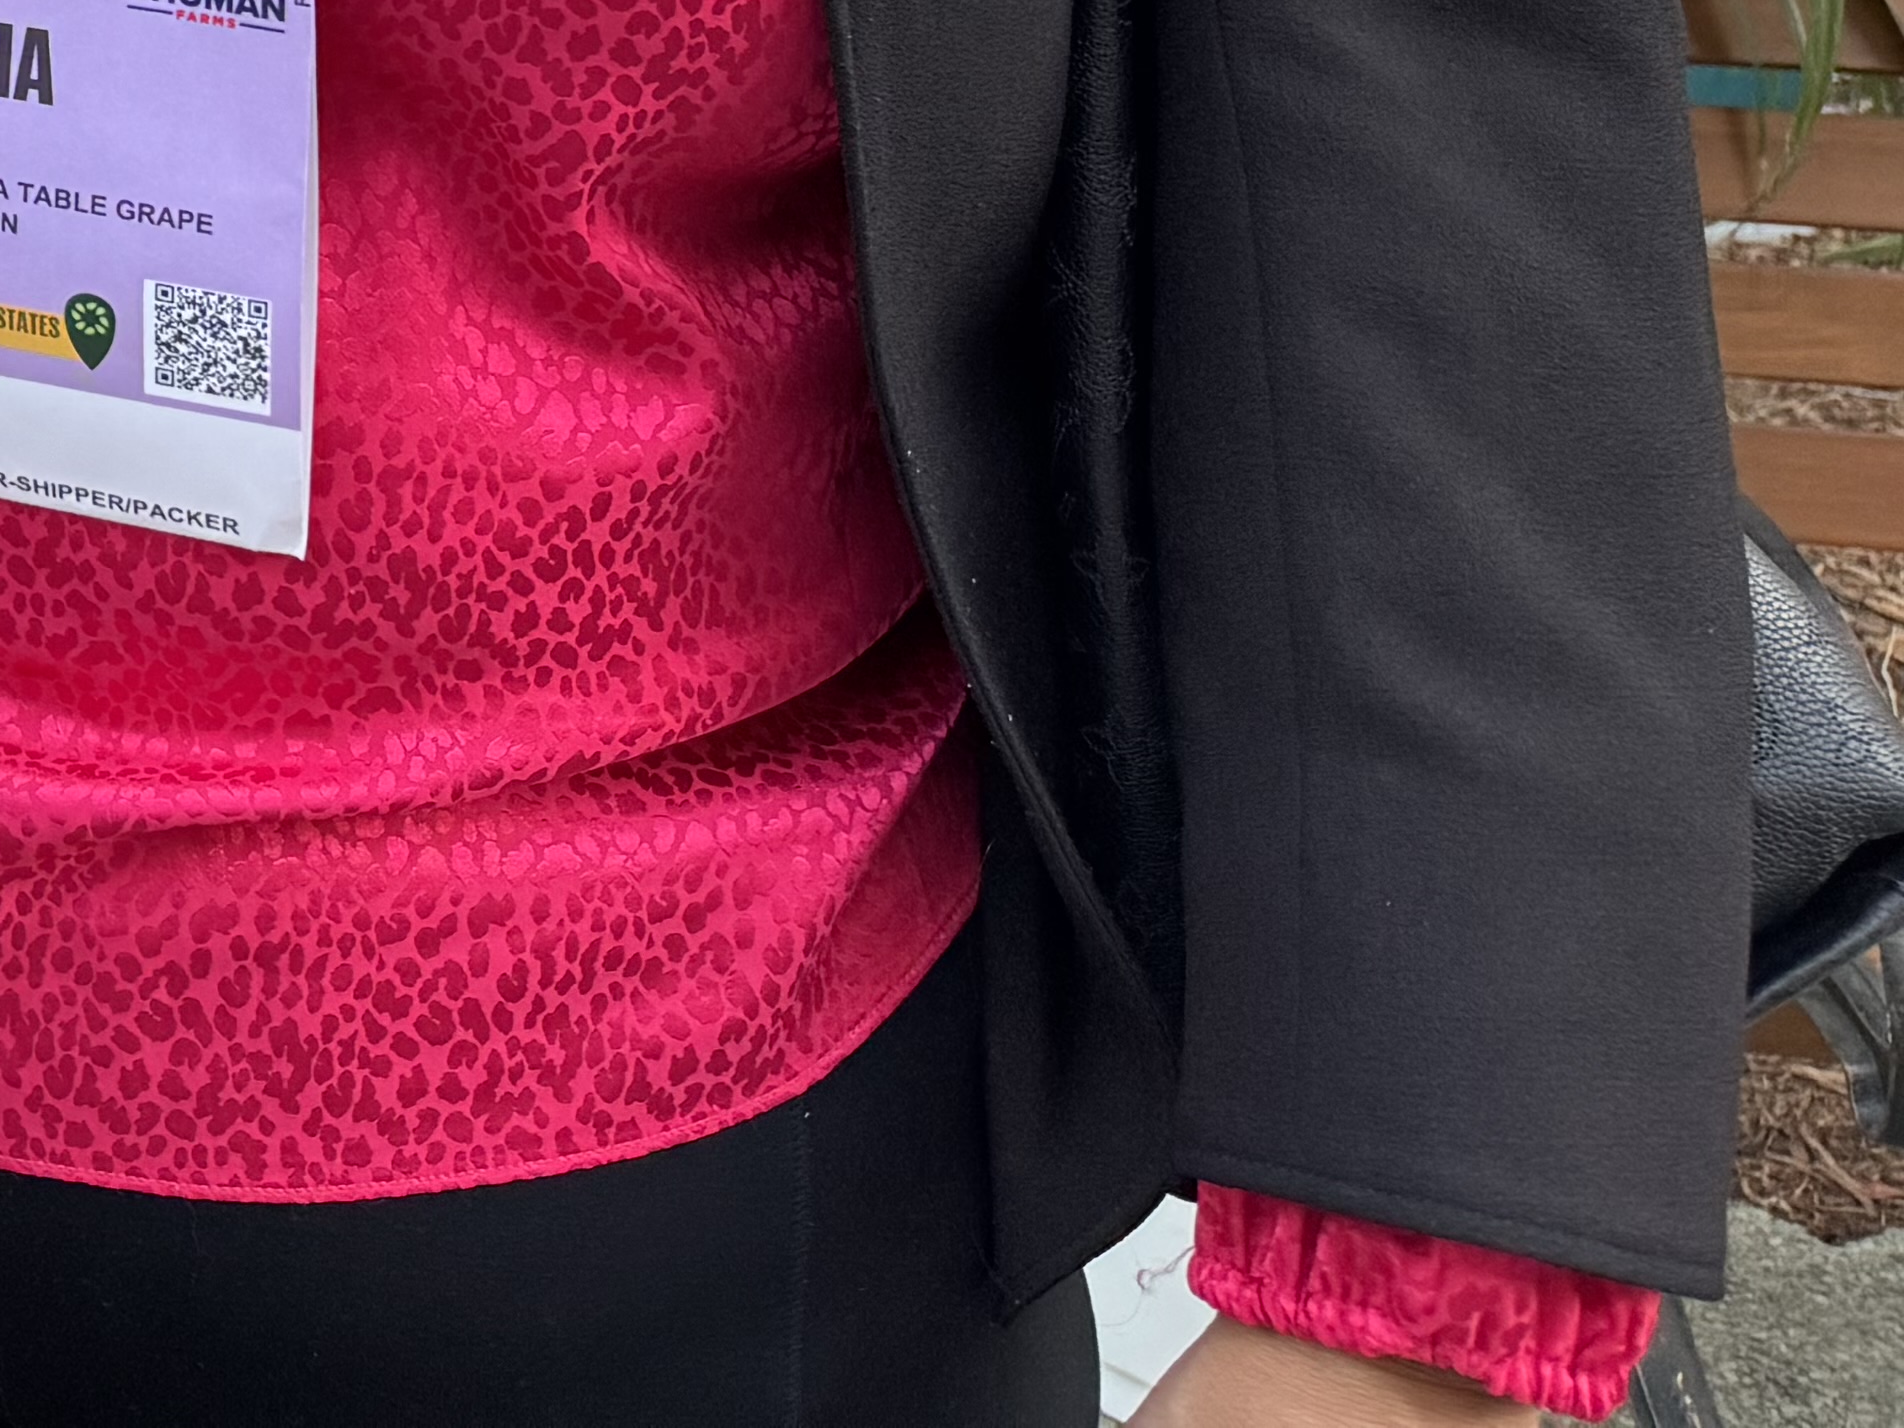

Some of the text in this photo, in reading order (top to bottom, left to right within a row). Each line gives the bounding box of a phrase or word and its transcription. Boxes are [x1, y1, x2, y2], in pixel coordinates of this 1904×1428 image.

[174, 9, 237, 29] FARMS
[17, 181, 107, 217] TABLE
[115, 199, 214, 236] GRAPE
